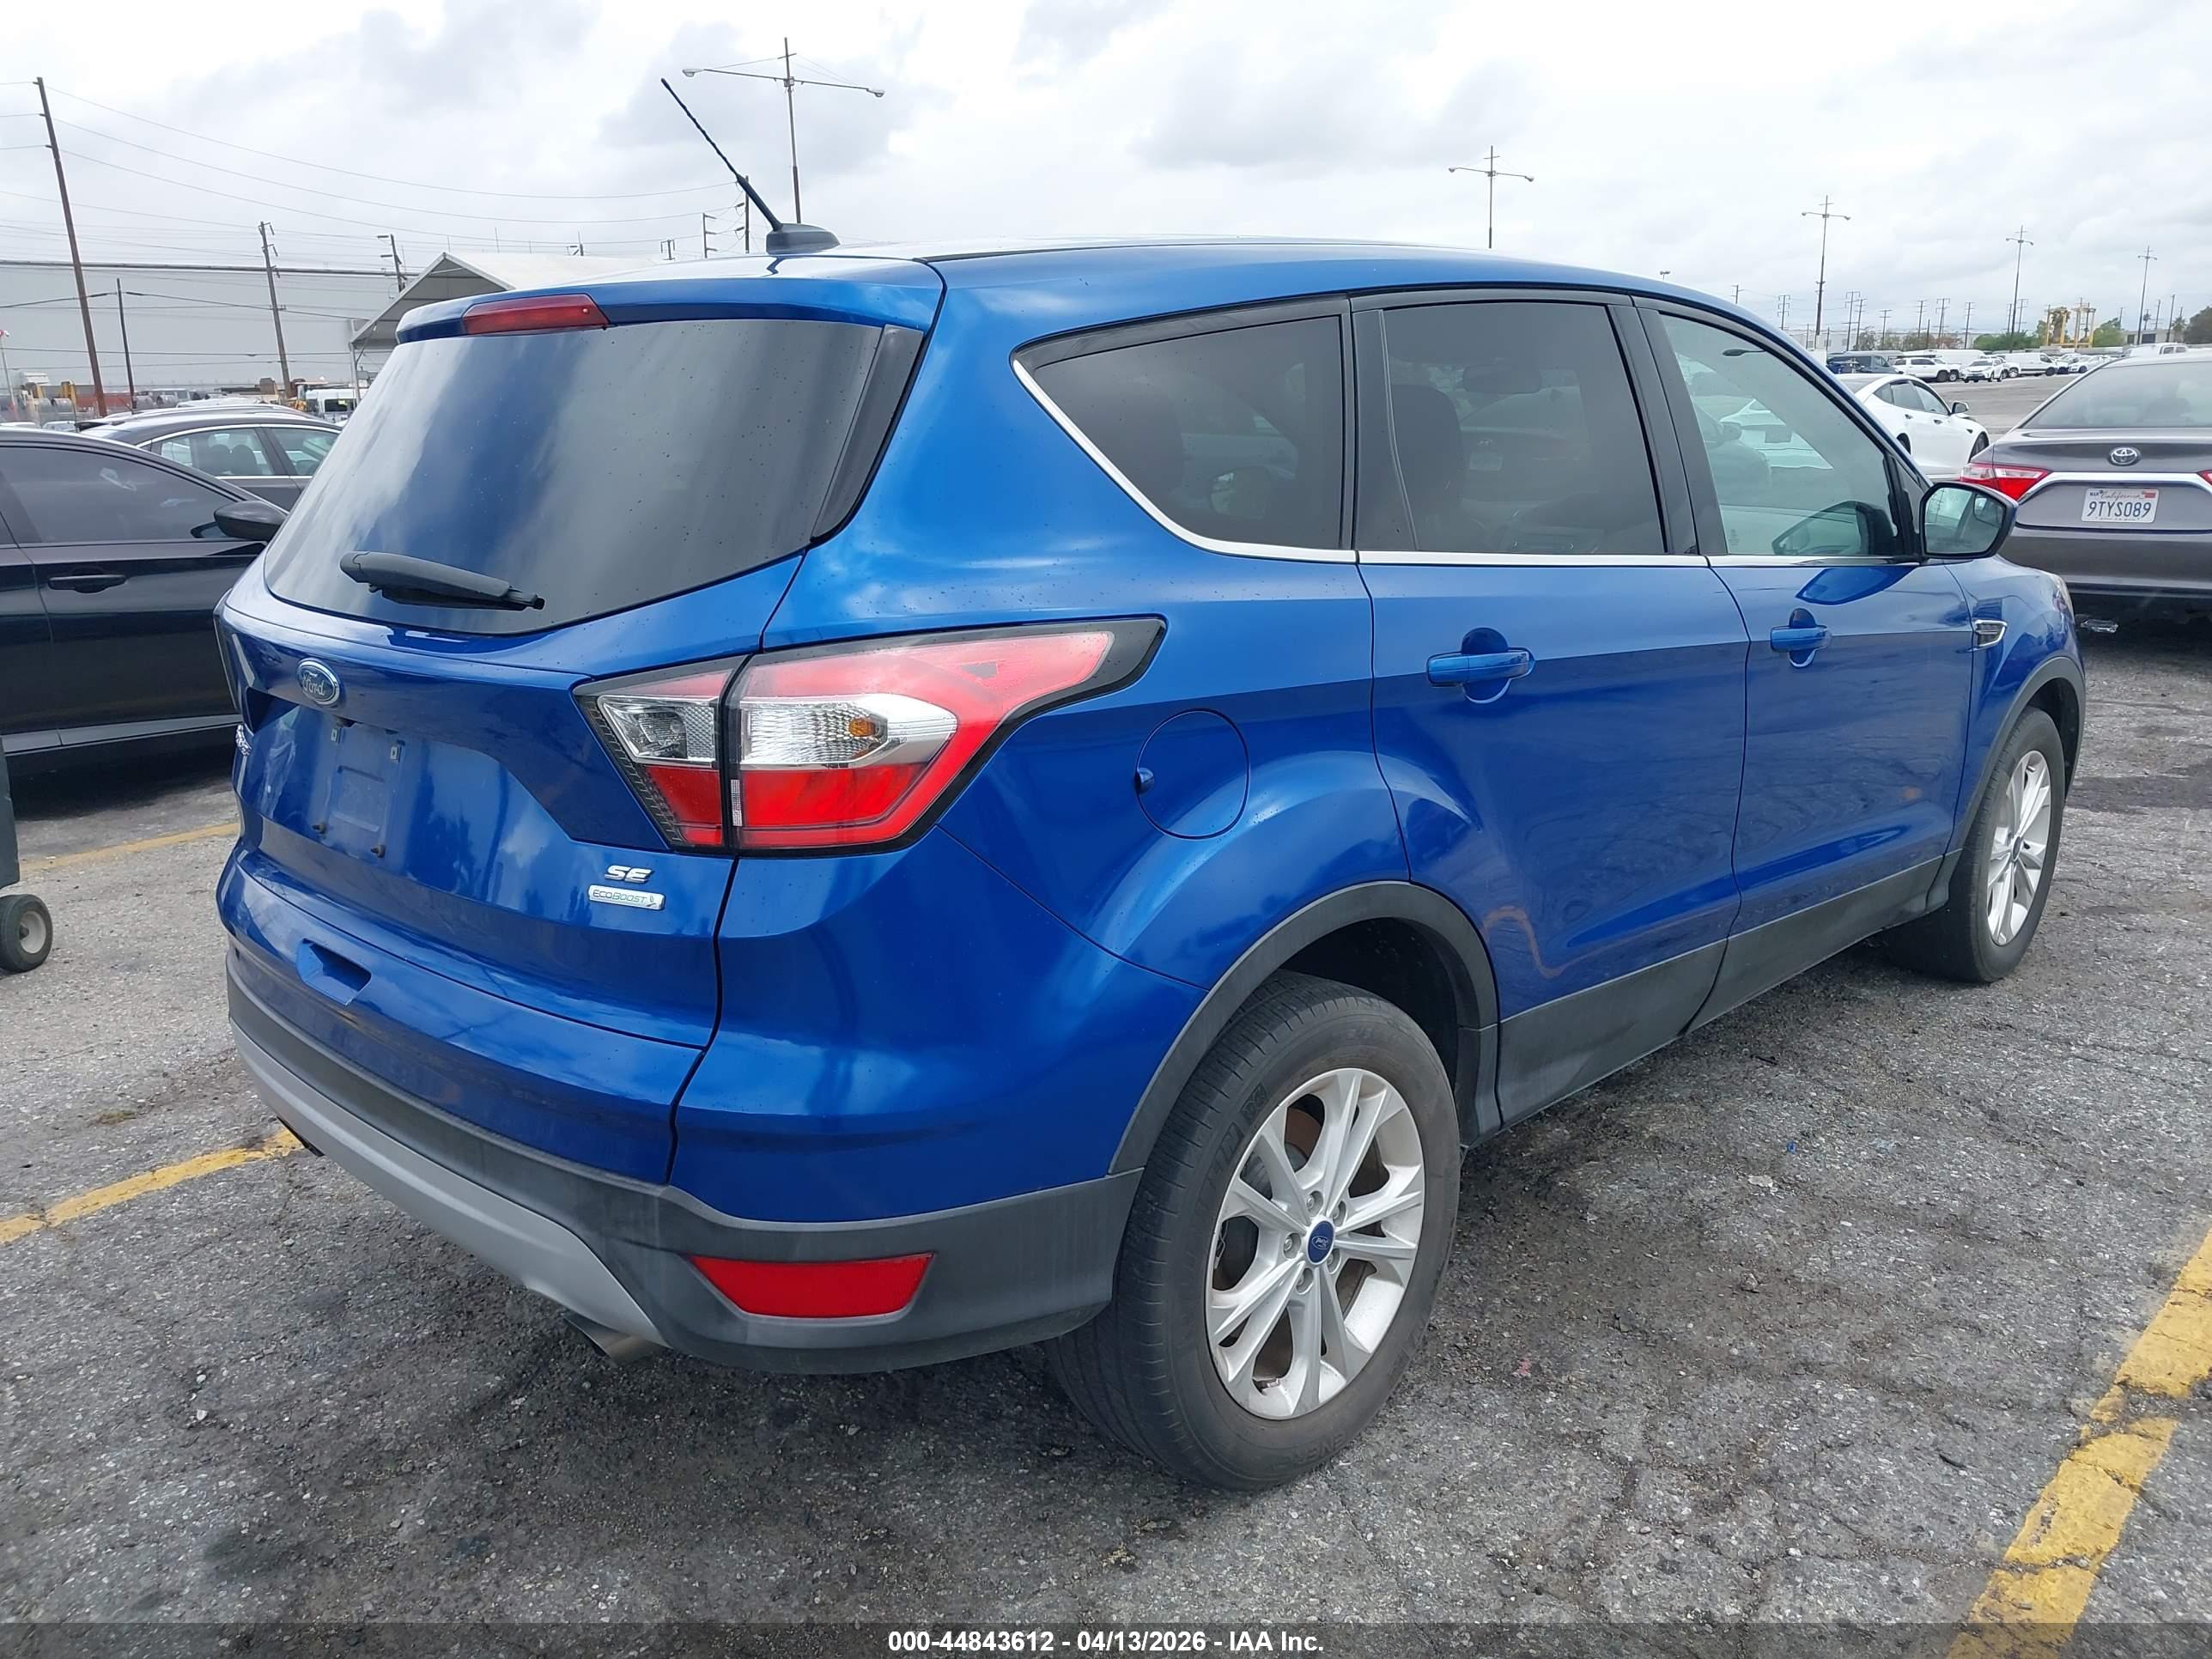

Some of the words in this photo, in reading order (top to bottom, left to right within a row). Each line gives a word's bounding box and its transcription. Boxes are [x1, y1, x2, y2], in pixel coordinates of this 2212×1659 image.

[2087, 501, 2152, 518] 9TYS089
[302, 671, 325, 696] Ford
[604, 865, 653, 884] SE
[592, 889, 647, 903] ECOBOOST
